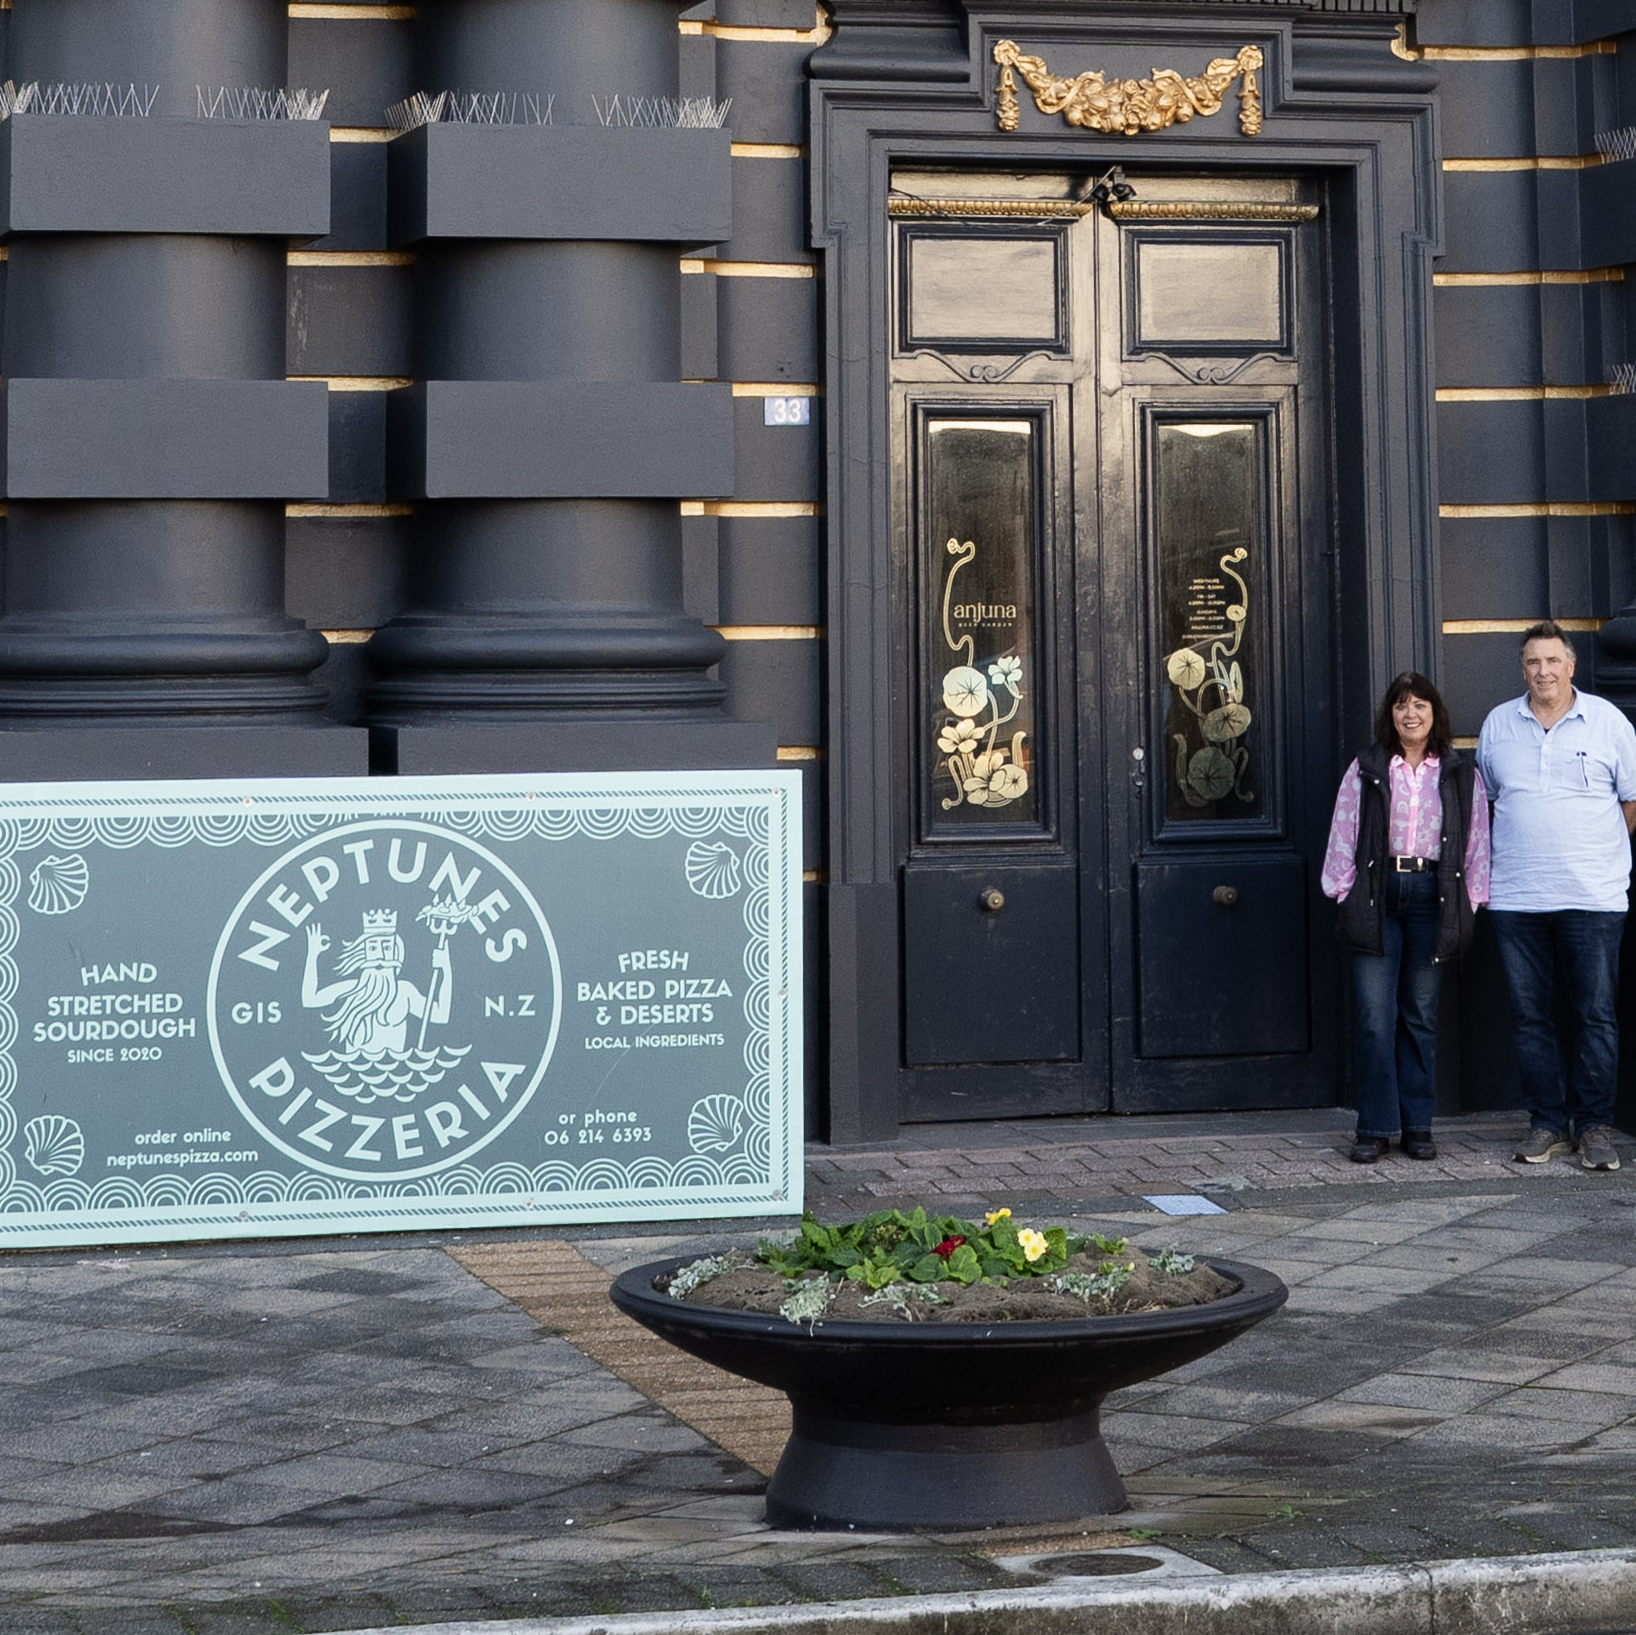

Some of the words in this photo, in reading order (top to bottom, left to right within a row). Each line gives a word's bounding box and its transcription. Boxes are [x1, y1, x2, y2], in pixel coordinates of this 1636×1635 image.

[774, 398, 802, 424] 33
[953, 602, 1017, 623] anjuna
[237, 838, 527, 972] NEPTUNES
[618, 949, 689, 973] FRESH
[81, 962, 157, 986] HAND
[577, 980, 655, 1001] BAKED
[665, 978, 733, 999] PIZZA
[48, 993, 183, 1016] STRETCHED
[231, 1001, 282, 1024] GIS
[485, 995, 535, 1016] N.Z
[596, 1006, 611, 1025] &
[621, 1003, 714, 1024] DESERTS
[33, 1018, 195, 1042] SOURDOUGH
[585, 1037, 630, 1049] LOCAL
[635, 1034, 725, 1048] INGREDIENTS
[67, 1048, 114, 1063] SINCE
[120, 1047, 162, 1062] 2020
[249, 1057, 526, 1161] PIZZERIA
[558, 1114, 576, 1124] or
[585, 1109, 637, 1127] phone
[135, 1130, 177, 1145] order
[183, 1128, 231, 1143] online
[544, 1130, 569, 1145] 06
[578, 1129, 604, 1144] 214
[612, 1127, 652, 1143] 6393
[107, 1149, 258, 1170] neptunespizza.com
